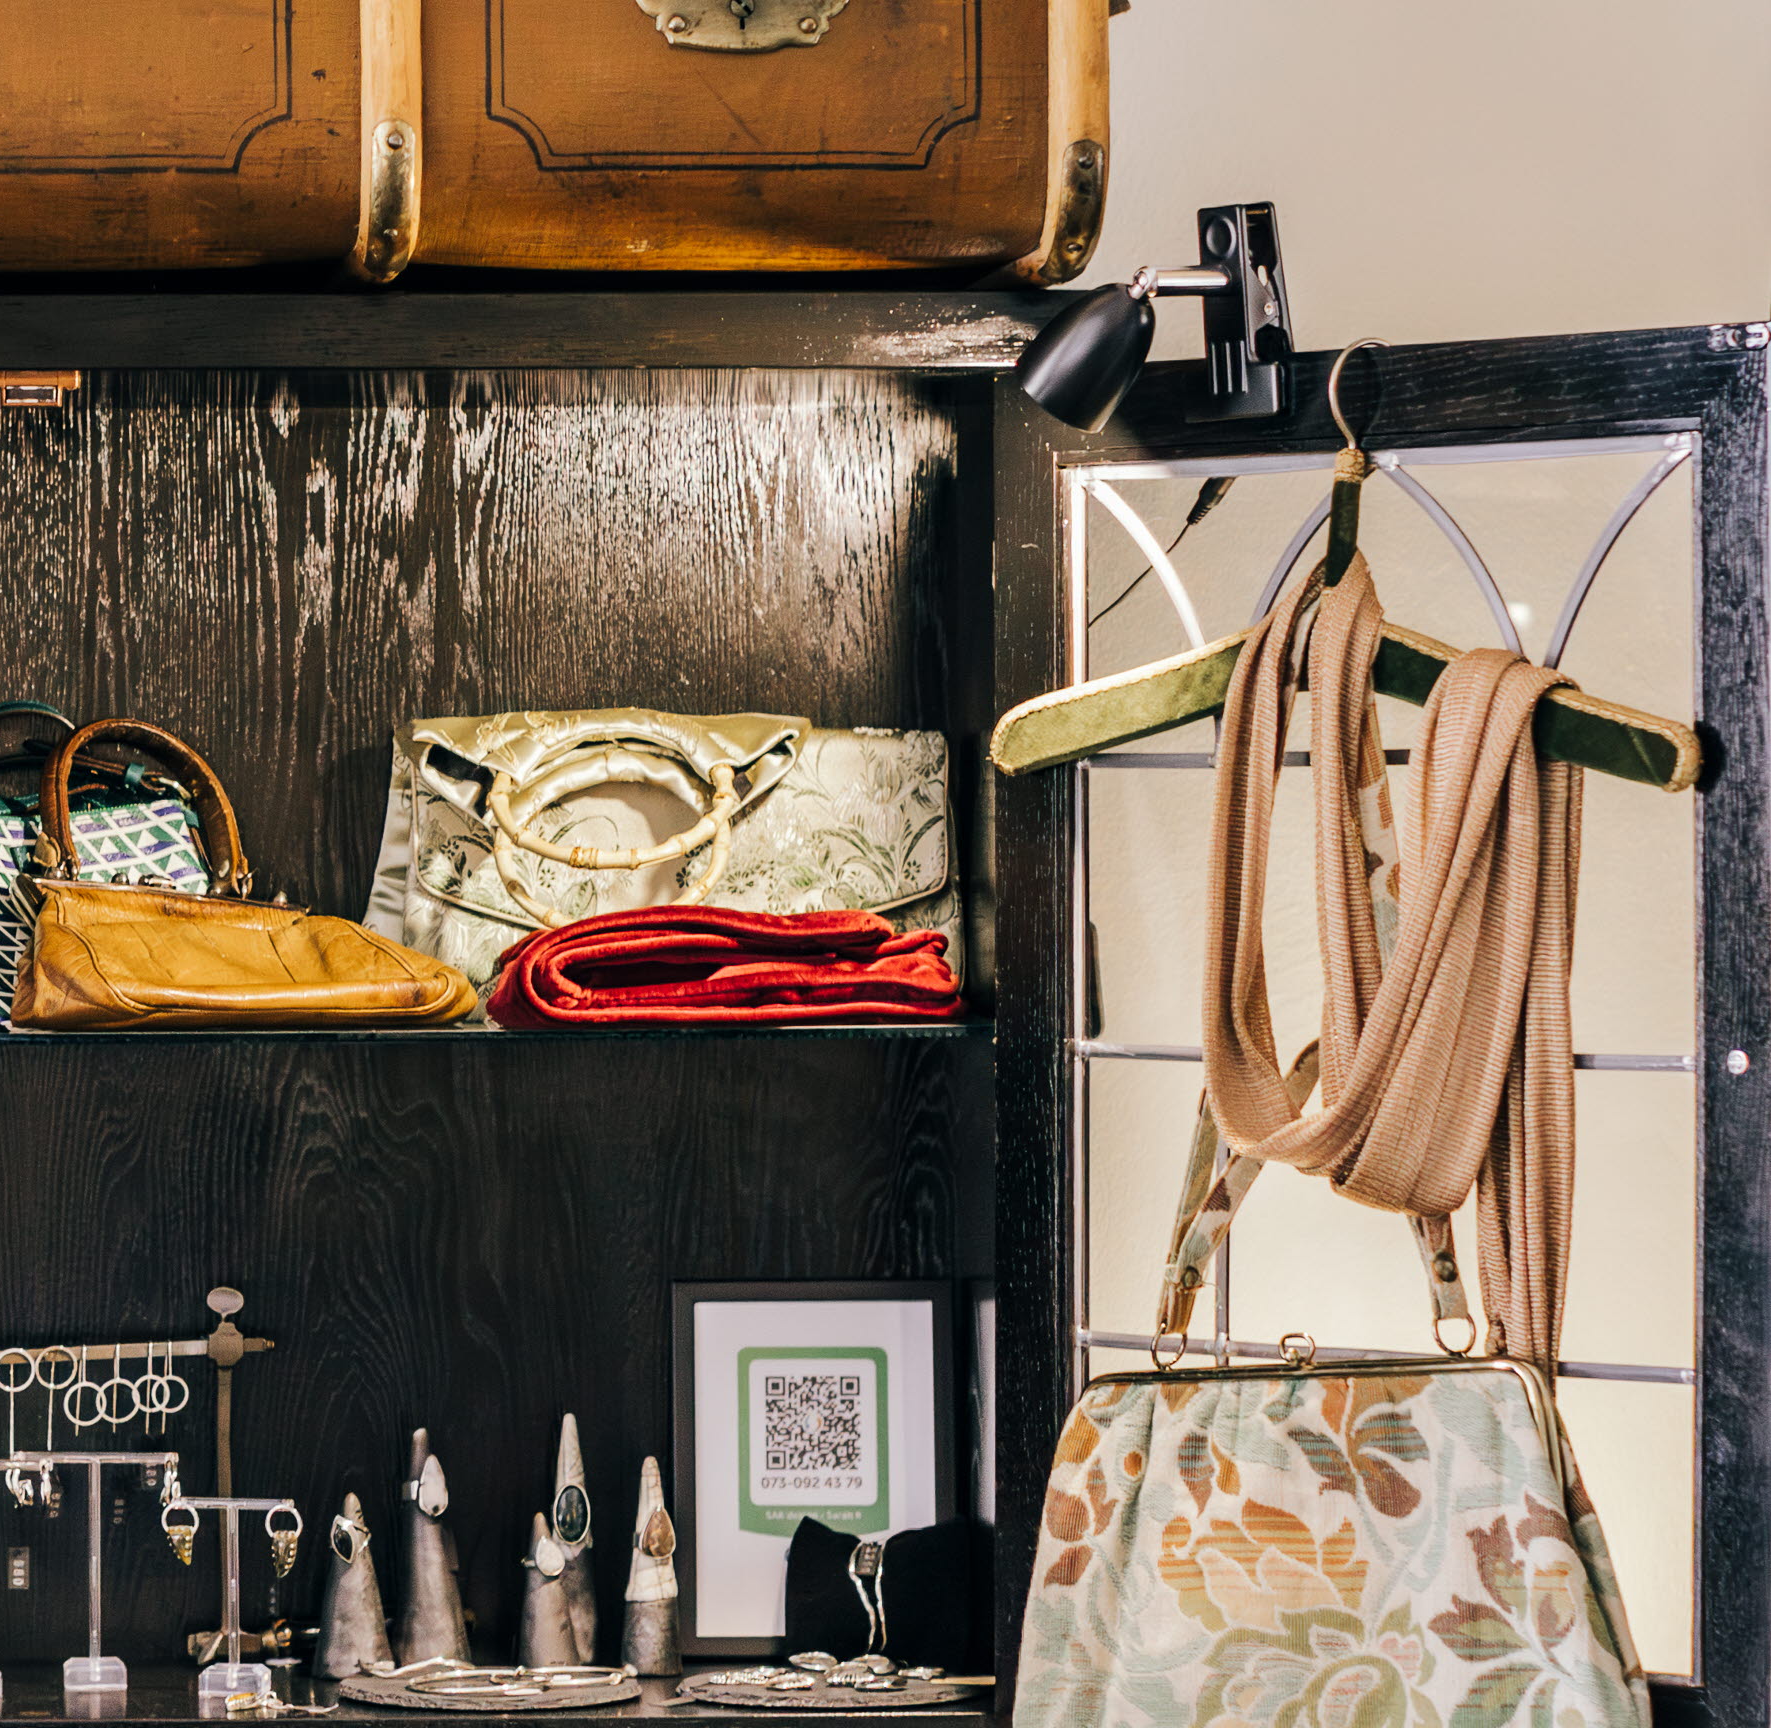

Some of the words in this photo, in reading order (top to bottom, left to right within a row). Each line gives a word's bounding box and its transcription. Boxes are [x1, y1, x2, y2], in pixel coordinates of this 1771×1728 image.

[761, 1476, 820, 1489] 073-092
[824, 1476, 842, 1489] 43
[846, 1475, 863, 1489] 79
